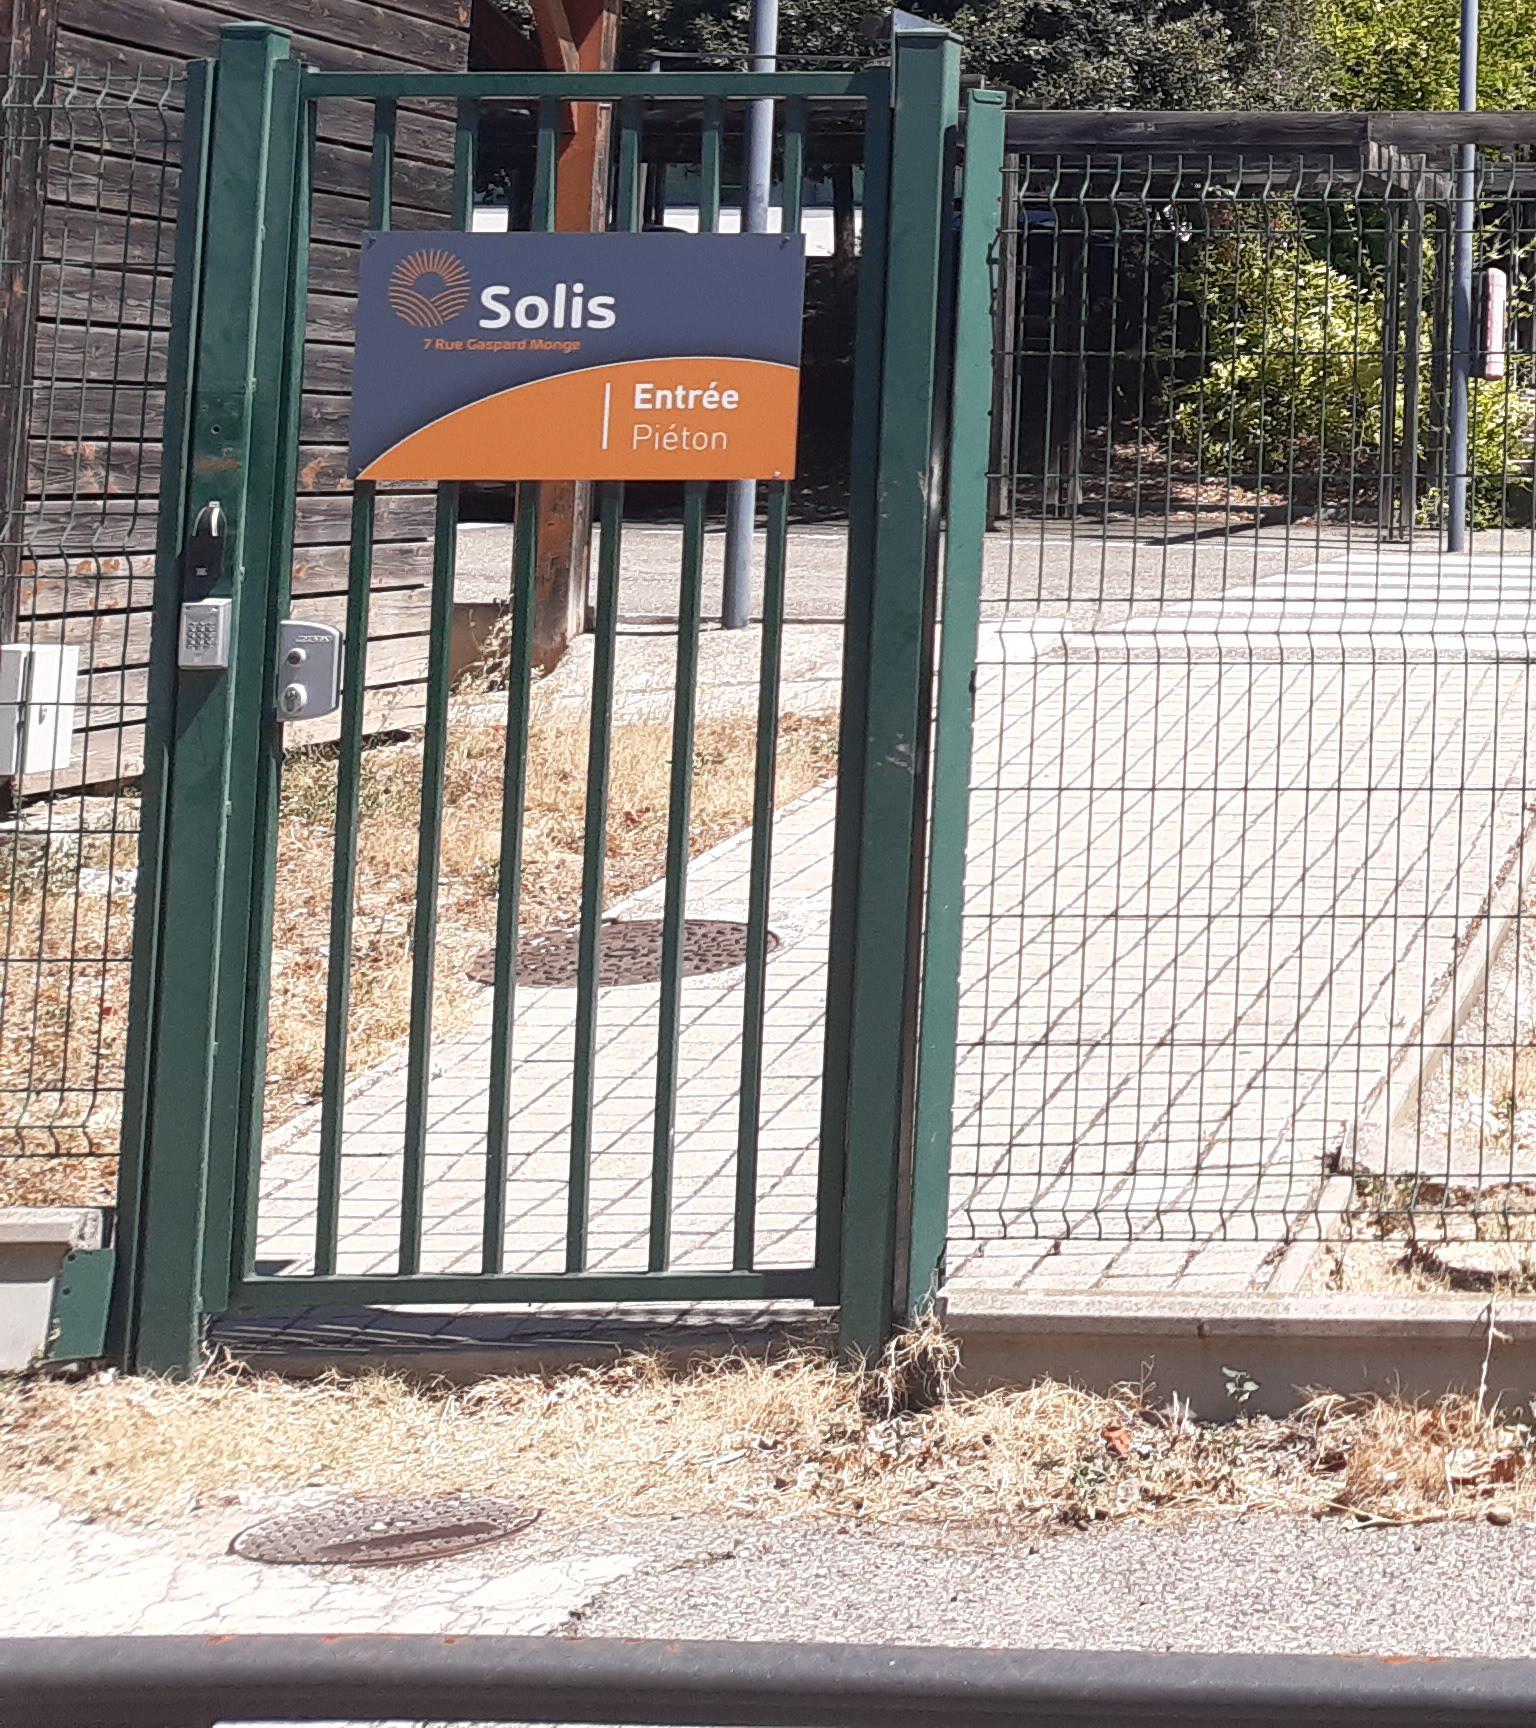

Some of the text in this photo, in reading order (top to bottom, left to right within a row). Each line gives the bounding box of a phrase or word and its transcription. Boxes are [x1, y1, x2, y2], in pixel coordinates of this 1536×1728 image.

[477, 282, 617, 330] Solis
[423, 338, 581, 354] 7 Rue Gaspard Monge
[633, 381, 739, 410] Entrée
[632, 422, 727, 451] Piéton
